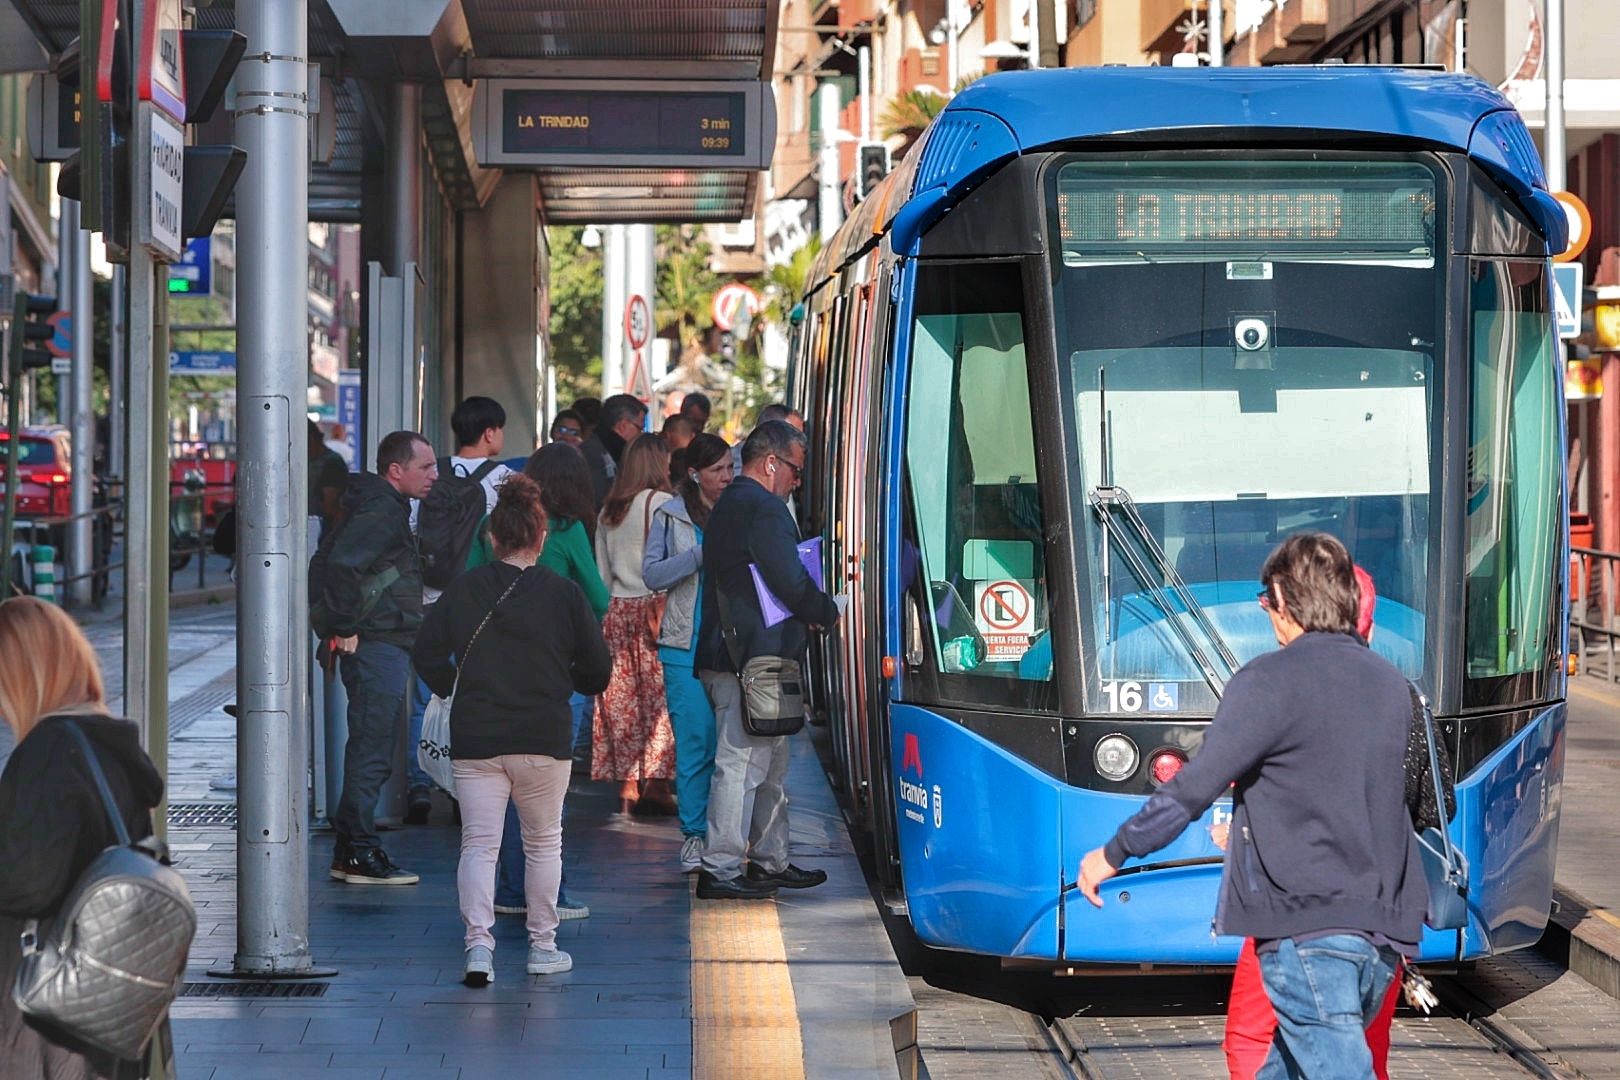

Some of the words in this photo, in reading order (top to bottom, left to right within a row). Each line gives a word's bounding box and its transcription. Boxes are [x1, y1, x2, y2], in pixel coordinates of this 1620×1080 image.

[518, 115, 534, 128] LA
[539, 115, 590, 128] TRINIDAD
[701, 118, 709, 129] 3
[711, 118, 730, 129] min
[1116, 194, 1160, 239] LA
[1174, 194, 1342, 239] TRINIDAD
[1007, 635, 1029, 644] FUERA
[1102, 681, 1143, 713] 16
